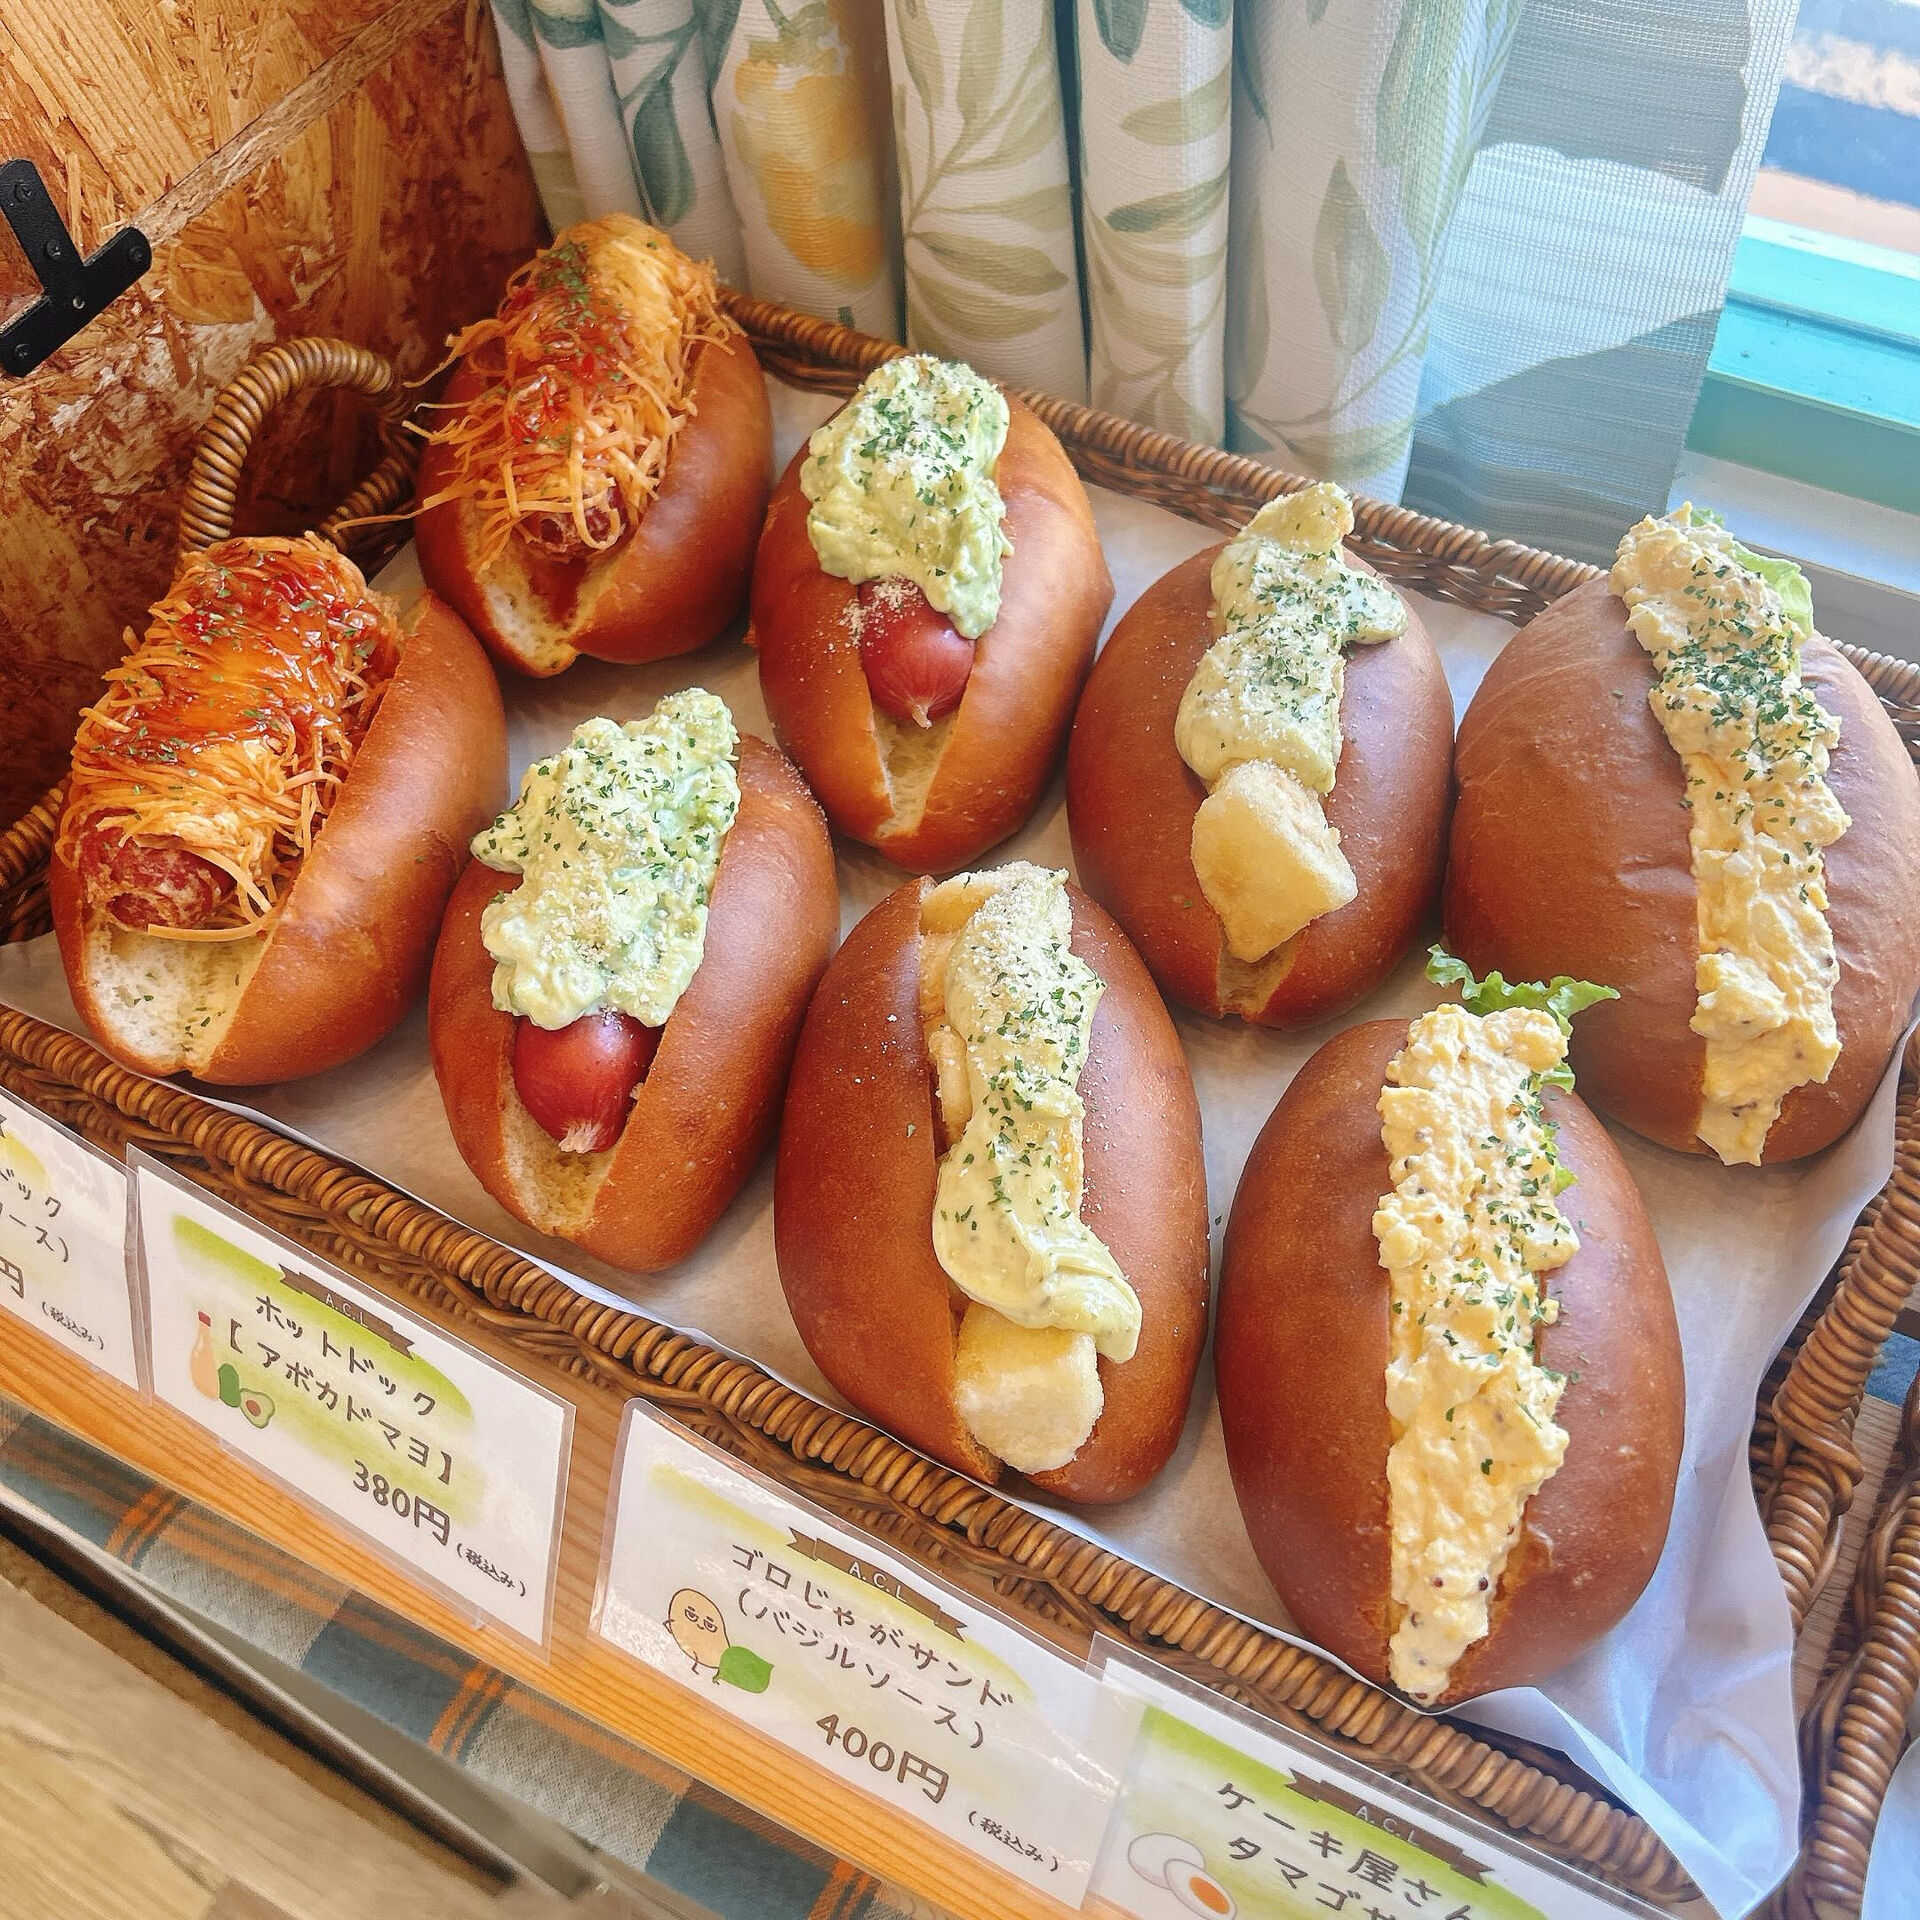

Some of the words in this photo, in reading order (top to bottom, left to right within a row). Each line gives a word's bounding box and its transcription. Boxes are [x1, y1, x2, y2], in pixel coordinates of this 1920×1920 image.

[0, 1201, 69, 1263] ース）
[256, 1296, 436, 1416] ホットドック
[353, 1459, 450, 1546] 380円
[457, 1543, 526, 1597] （税込み）
[732, 1544, 1014, 1706] ゴロじゃがサンド
[738, 1588, 983, 1749] （バジルソース）
[816, 1714, 950, 1804] 400円
[968, 1811, 1058, 1872] （税込み）
